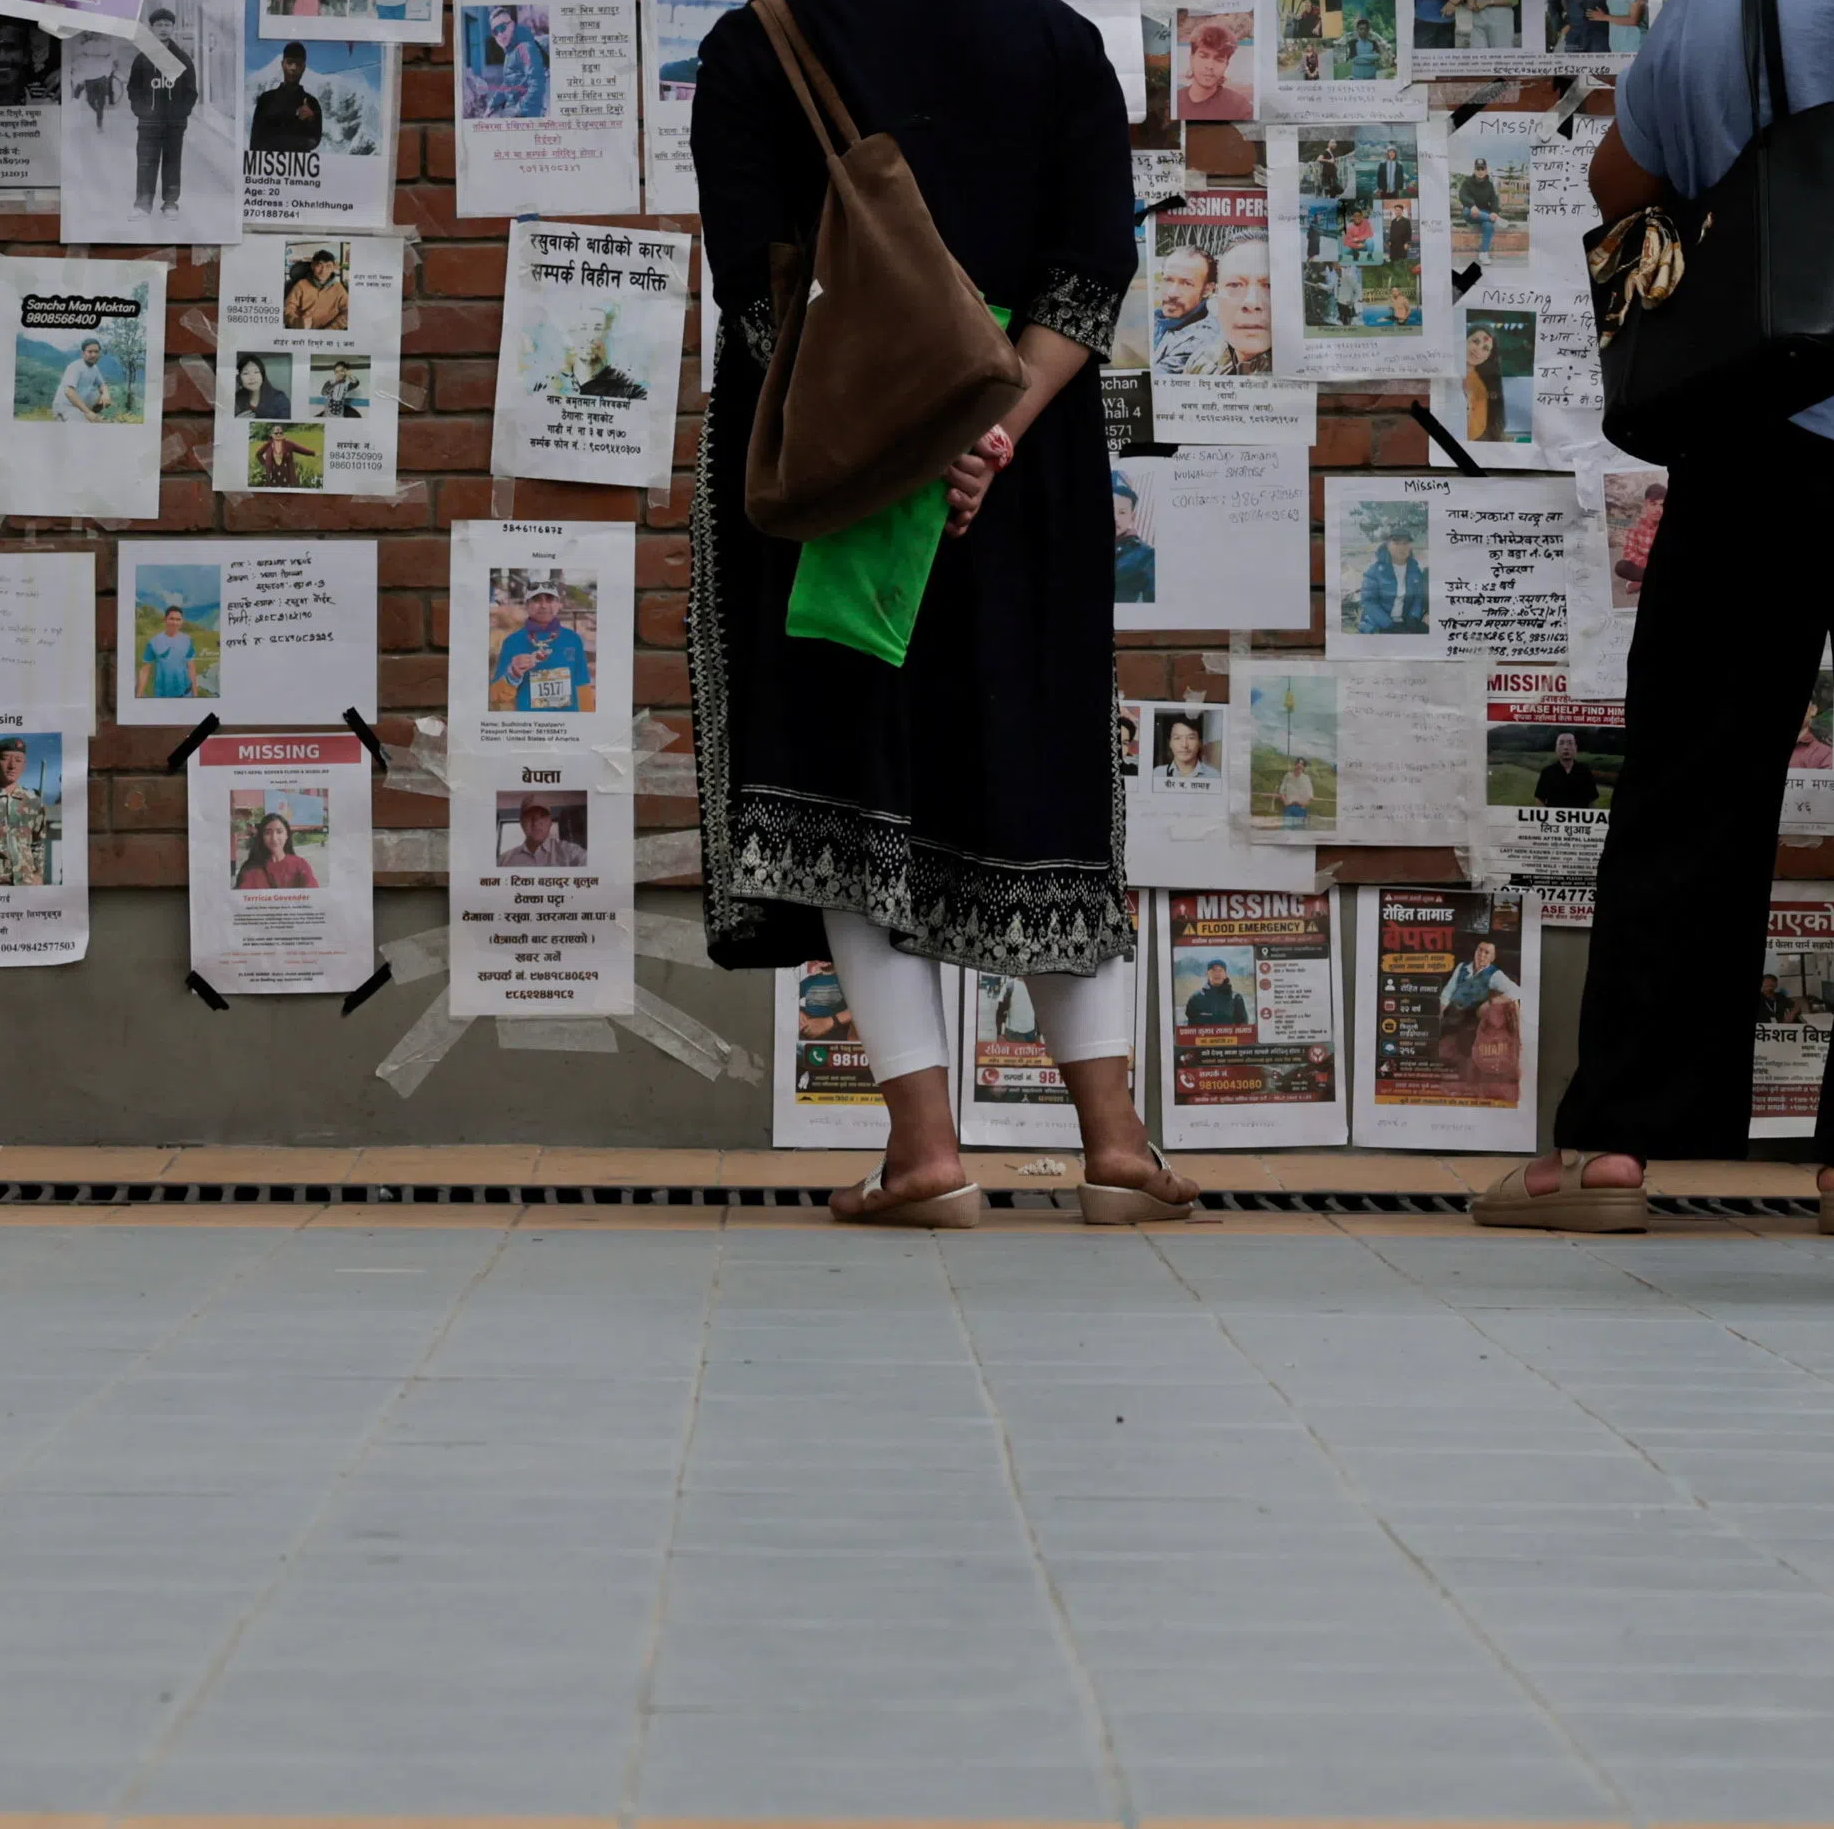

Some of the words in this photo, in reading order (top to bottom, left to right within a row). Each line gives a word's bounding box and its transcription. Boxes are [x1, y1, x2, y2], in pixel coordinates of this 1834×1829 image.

[244, 150, 320, 177] MISSING
[245, 177, 281, 185] Buddha
[284, 178, 321, 189] Tamang
[26, 299, 65, 312] Sancha
[68, 301, 93, 312] Man
[95, 301, 136, 313] Moktan
[26, 313, 96, 325] 9808566400
[239, 744, 320, 762] MISSING
[522, 767, 562, 783] बेपत्ता
[1196, 893, 1305, 919] MISSING
[1202, 924, 1235, 933] FLOOD
[1239, 923, 1301, 933] EMERGENCY
